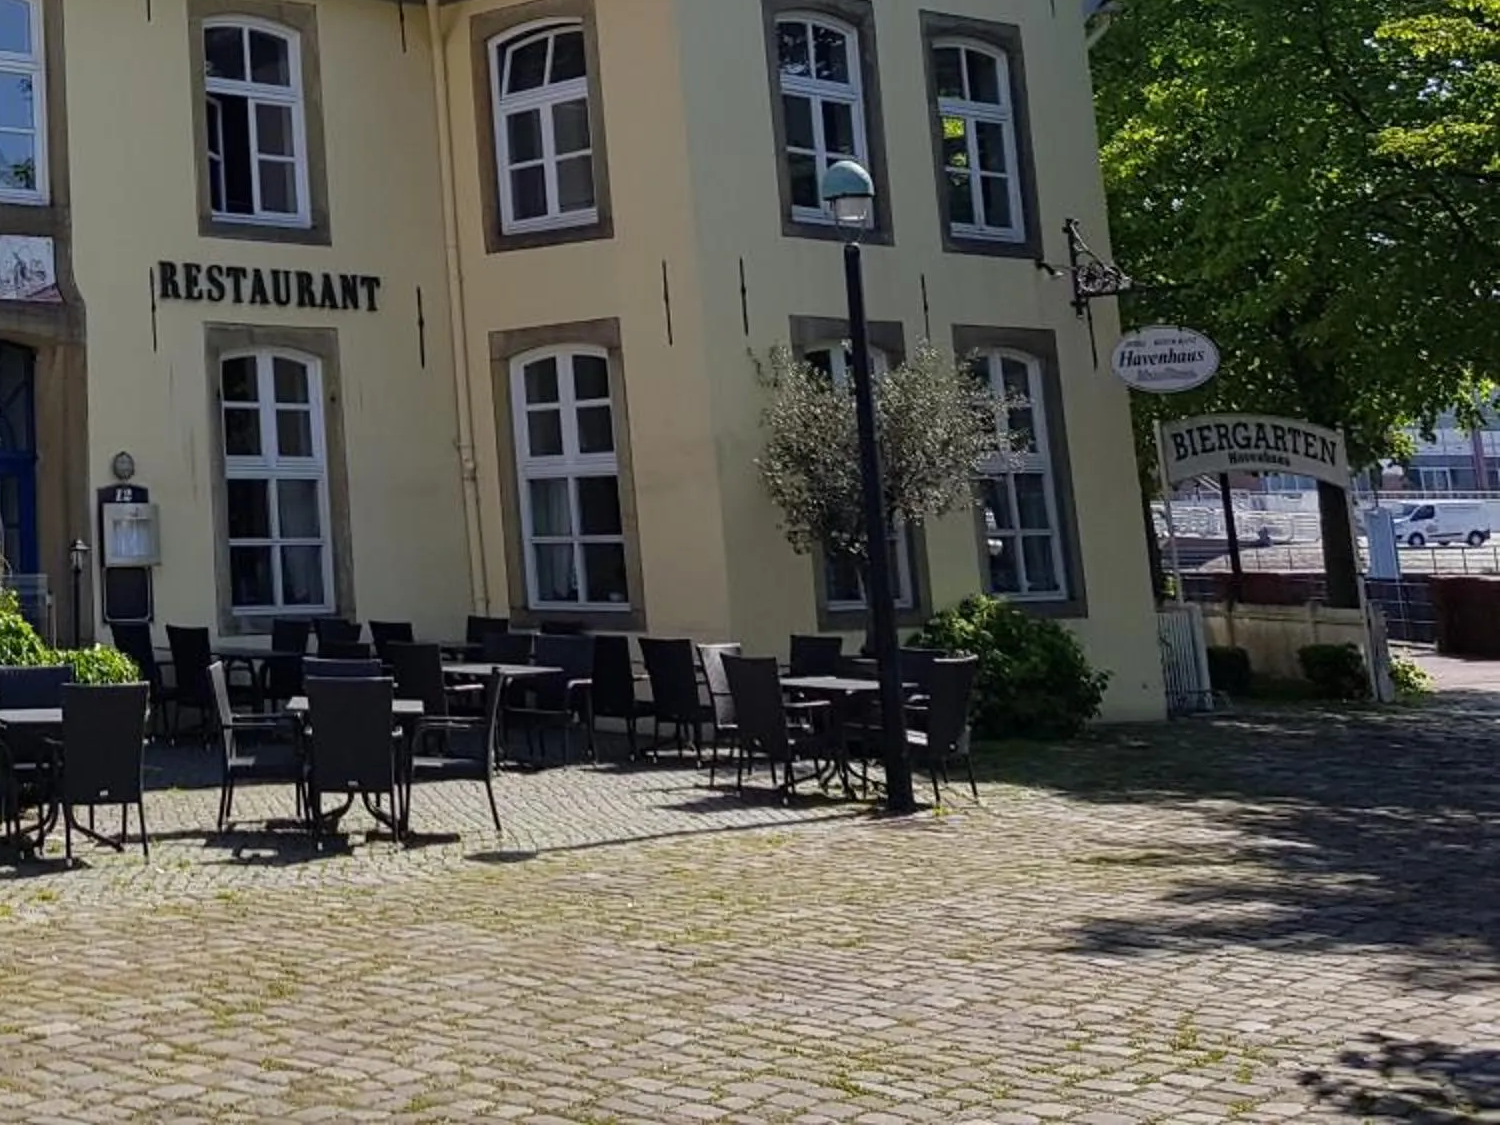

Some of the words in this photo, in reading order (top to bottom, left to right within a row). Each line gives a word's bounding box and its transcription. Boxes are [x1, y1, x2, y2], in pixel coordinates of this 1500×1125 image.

[157, 259, 382, 313] RESTAURANT
[1118, 347, 1205, 368] Havenhaus
[1171, 421, 1338, 467] BIERGARTEN
